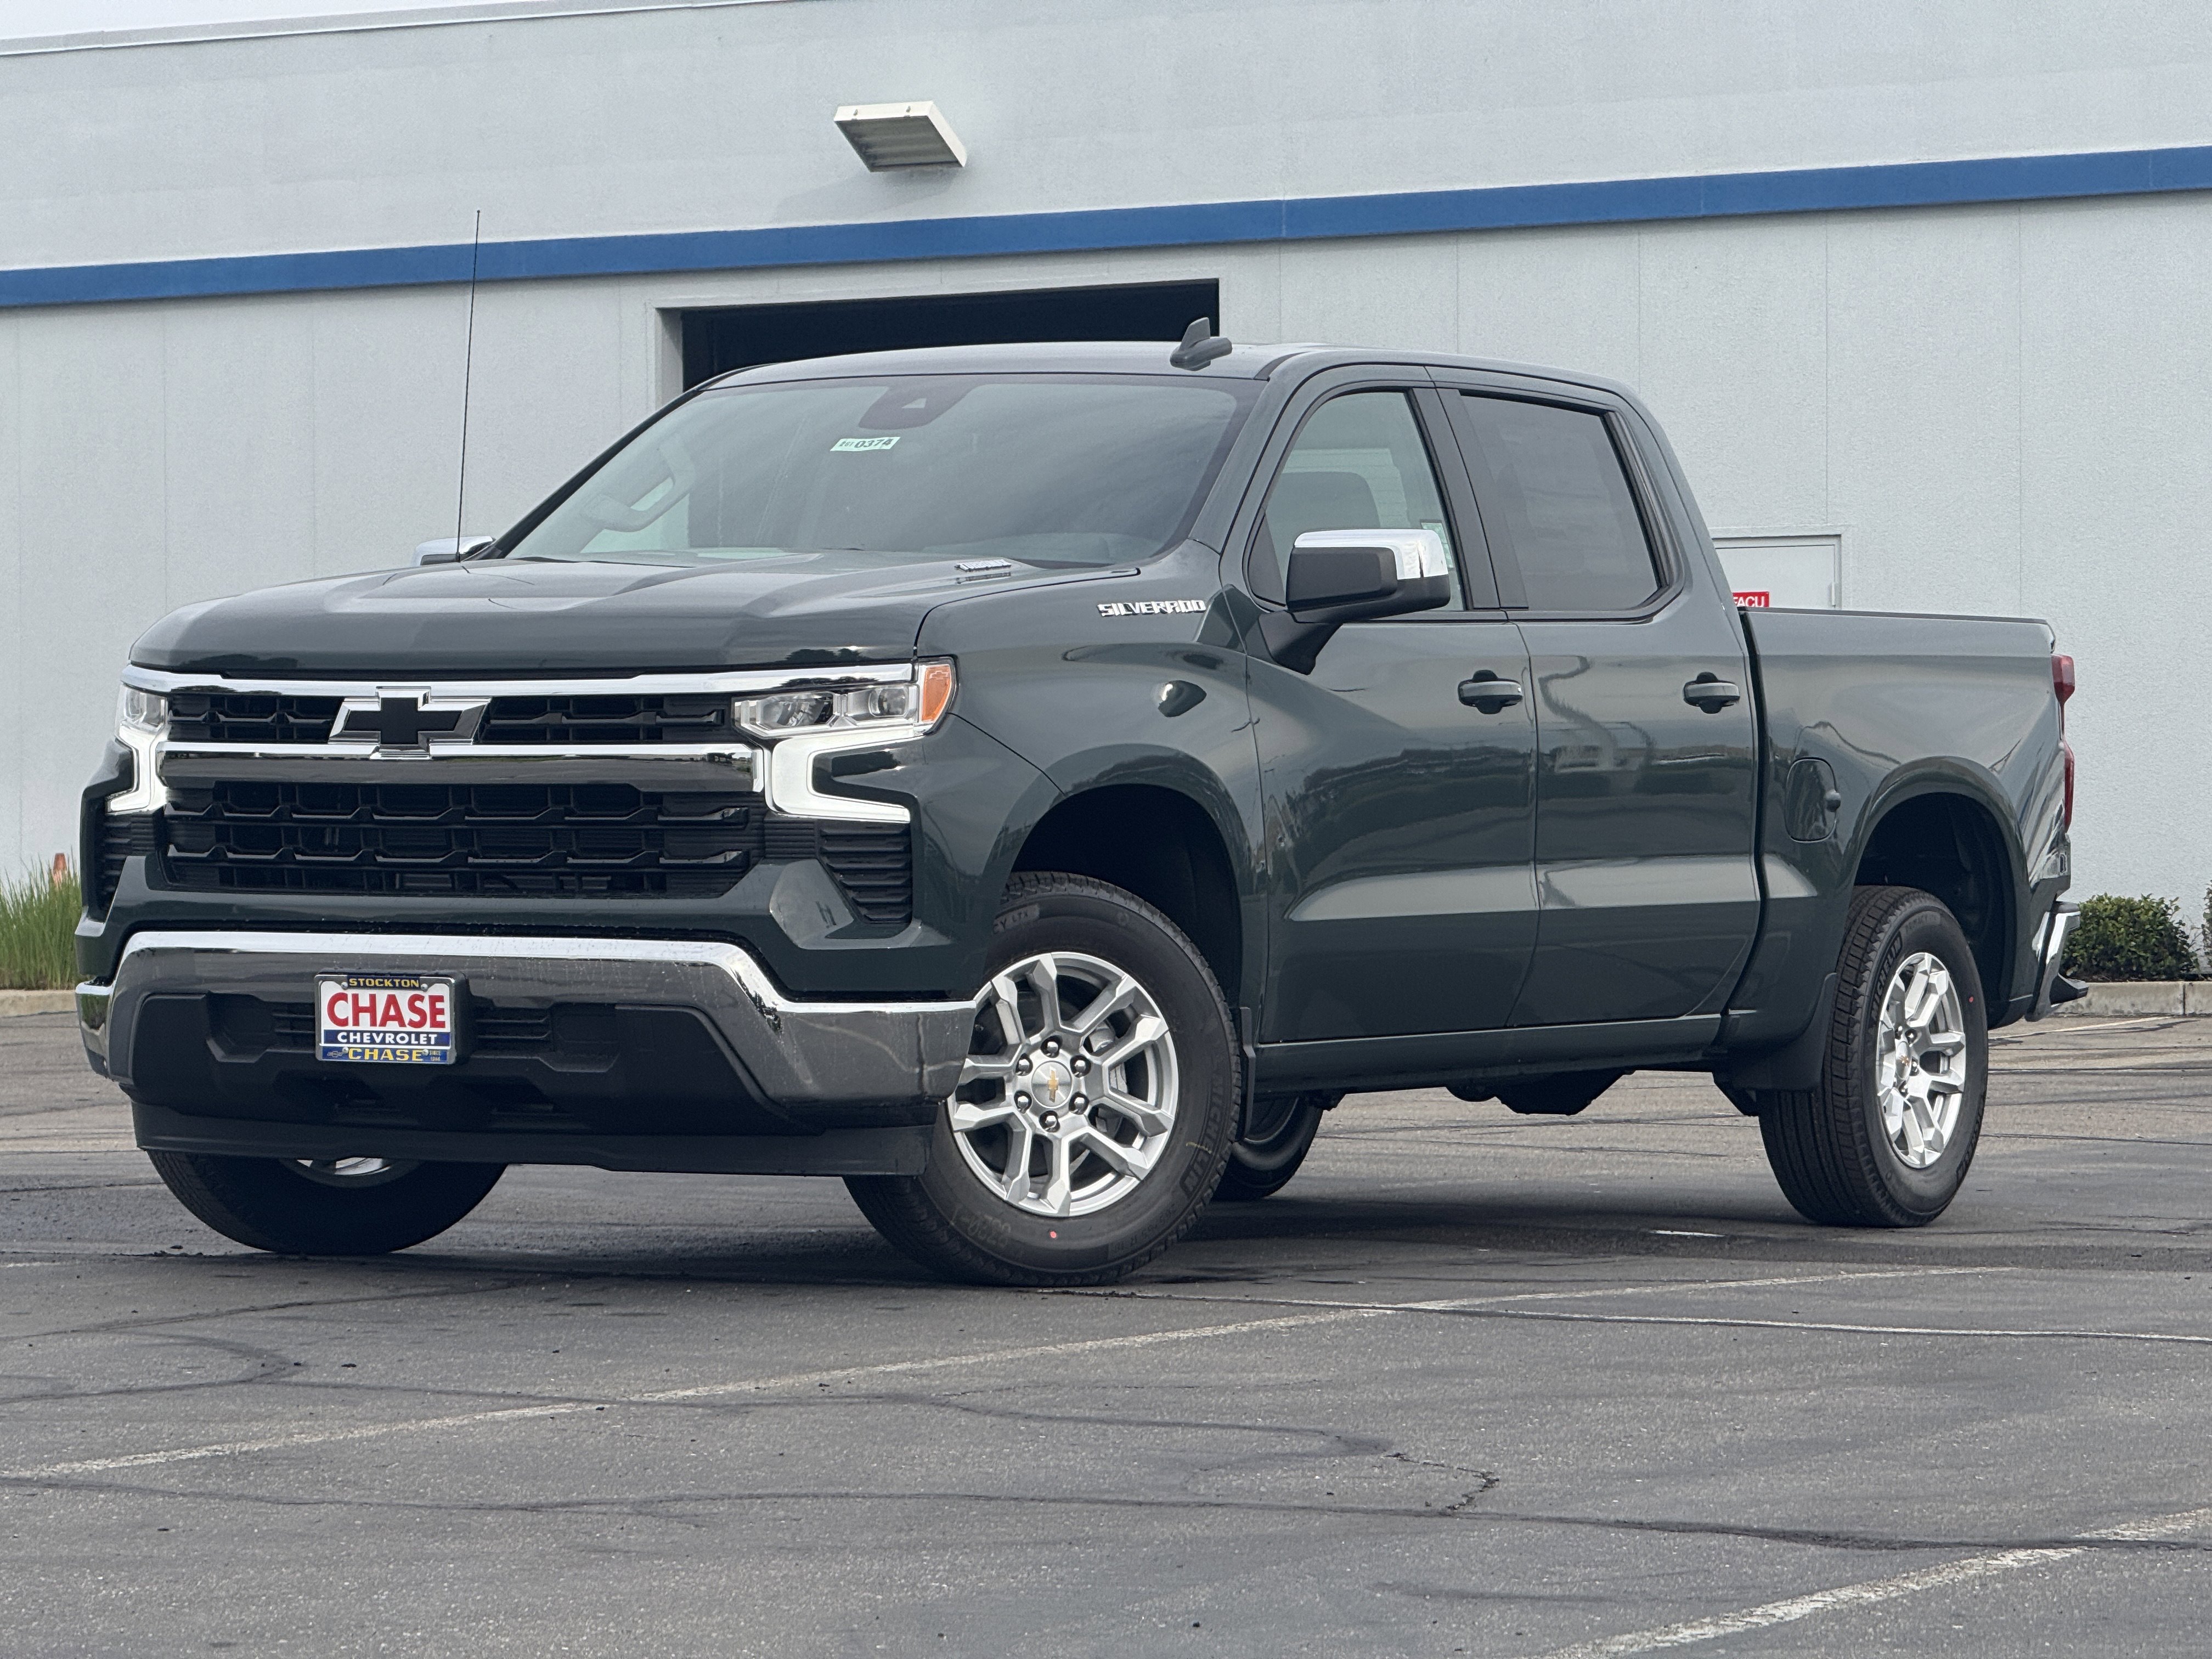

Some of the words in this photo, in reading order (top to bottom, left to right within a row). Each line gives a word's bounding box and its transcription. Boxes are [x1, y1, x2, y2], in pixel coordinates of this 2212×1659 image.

[1097, 600, 1206, 617] SILVERADO
[349, 978, 419, 988] STOCKTON
[327, 992, 446, 1029] CHASE
[337, 1031, 438, 1045] CHEVROLET
[348, 1048, 425, 1062] CHASE
